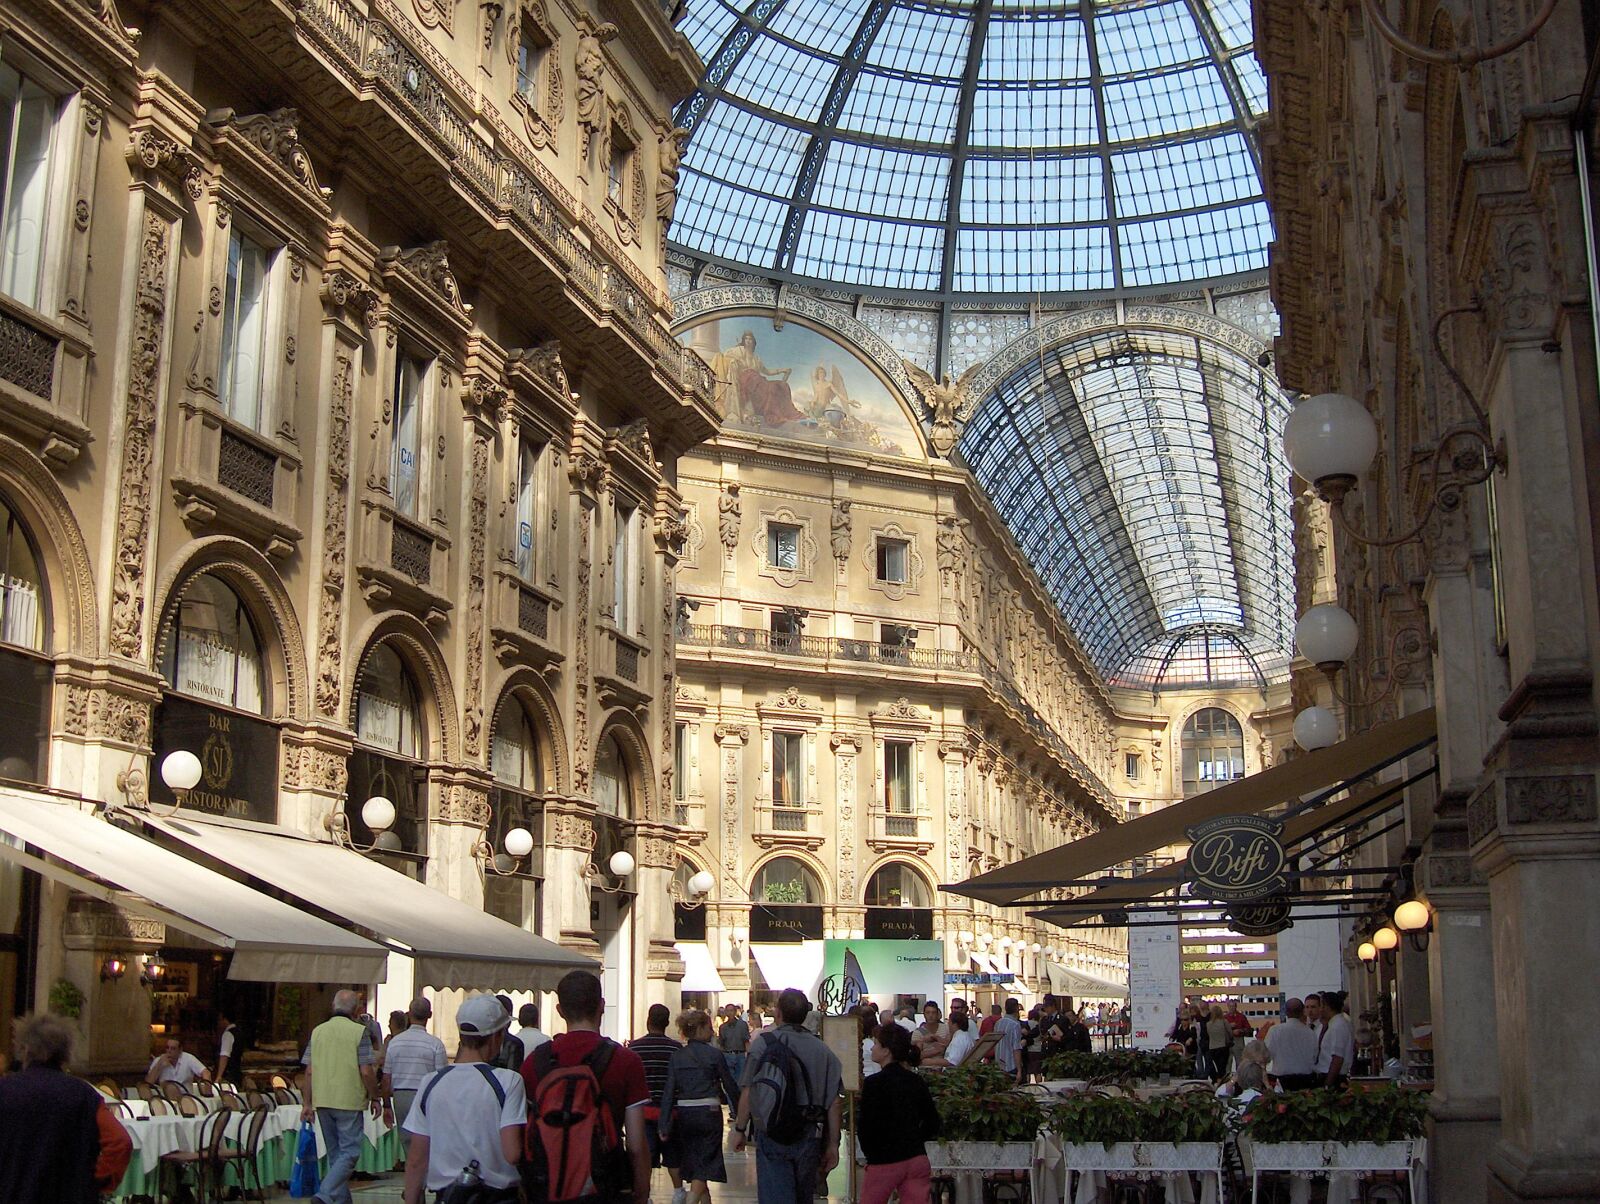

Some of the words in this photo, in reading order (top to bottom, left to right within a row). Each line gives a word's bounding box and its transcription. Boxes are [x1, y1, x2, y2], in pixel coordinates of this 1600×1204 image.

[187, 679, 225, 699] RISTORANTE
[208, 712, 231, 733] BAR
[212, 746, 224, 778] SI
[182, 789, 249, 815] RISTORANTE
[1200, 833, 1271, 885] Biffi
[1243, 886, 1268, 898] MILANO
[768, 920, 804, 929] PRADA
[881, 922, 915, 931] PRADA
[1135, 1030, 1148, 1039] 3M
